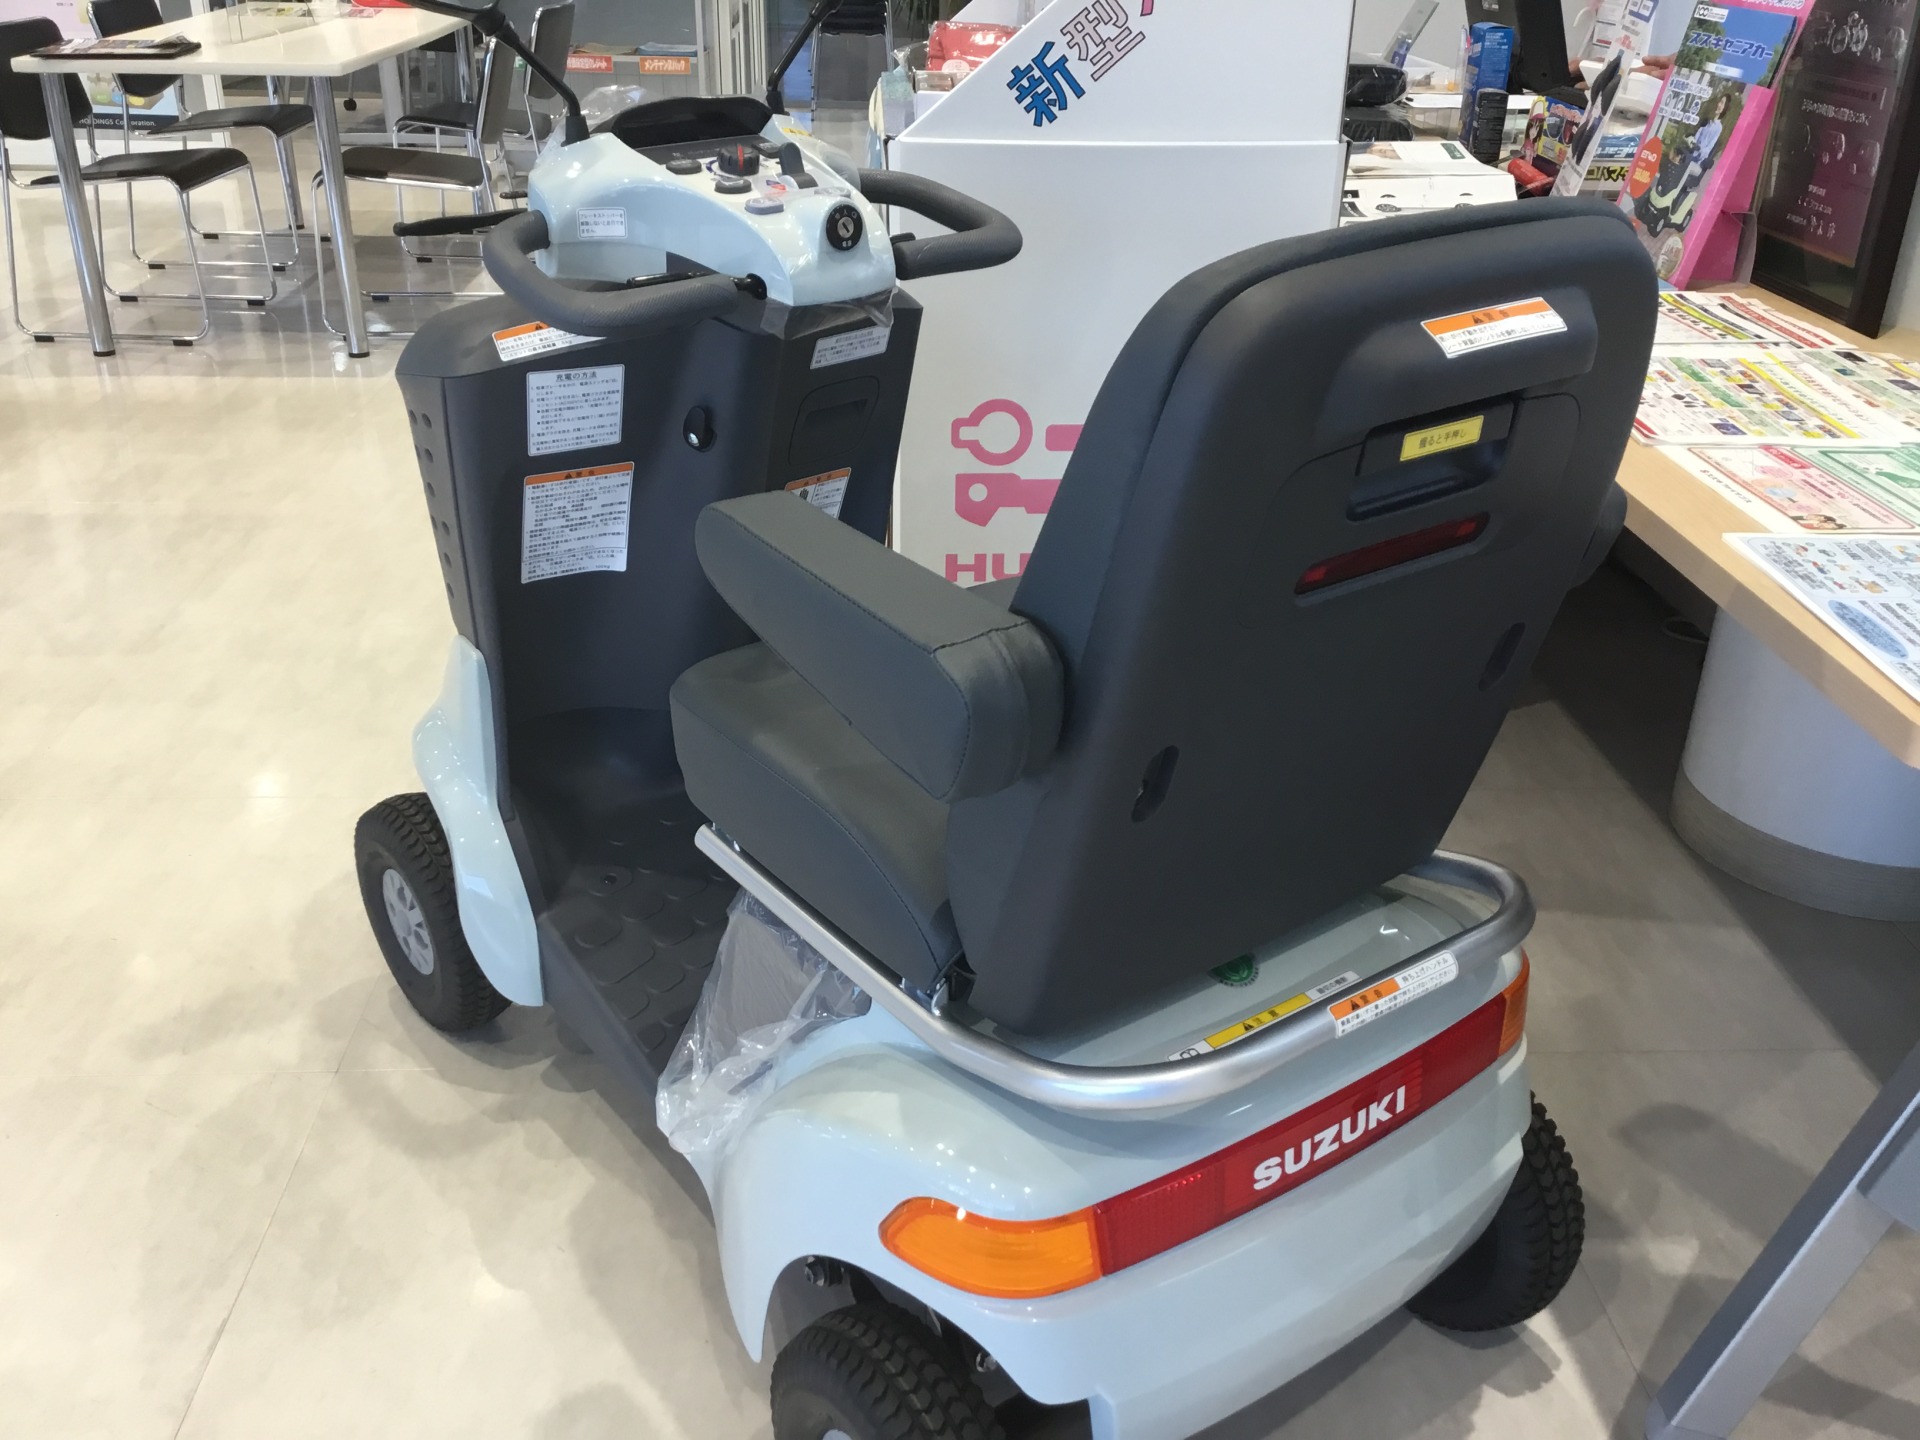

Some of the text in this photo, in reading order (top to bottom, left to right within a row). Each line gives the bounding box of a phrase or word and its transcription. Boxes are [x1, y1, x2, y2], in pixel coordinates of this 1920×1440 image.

[1686, 30, 1774, 60] スズキセニアカー
[1006, 0, 1152, 127] 新型
[555, 370, 598, 382] 充電の方法
[1418, 428, 1468, 450] 握ると手押し
[1401, 957, 1449, 985] 持ち上げハンドル
[1252, 1085, 1406, 1191] SUZUKI
